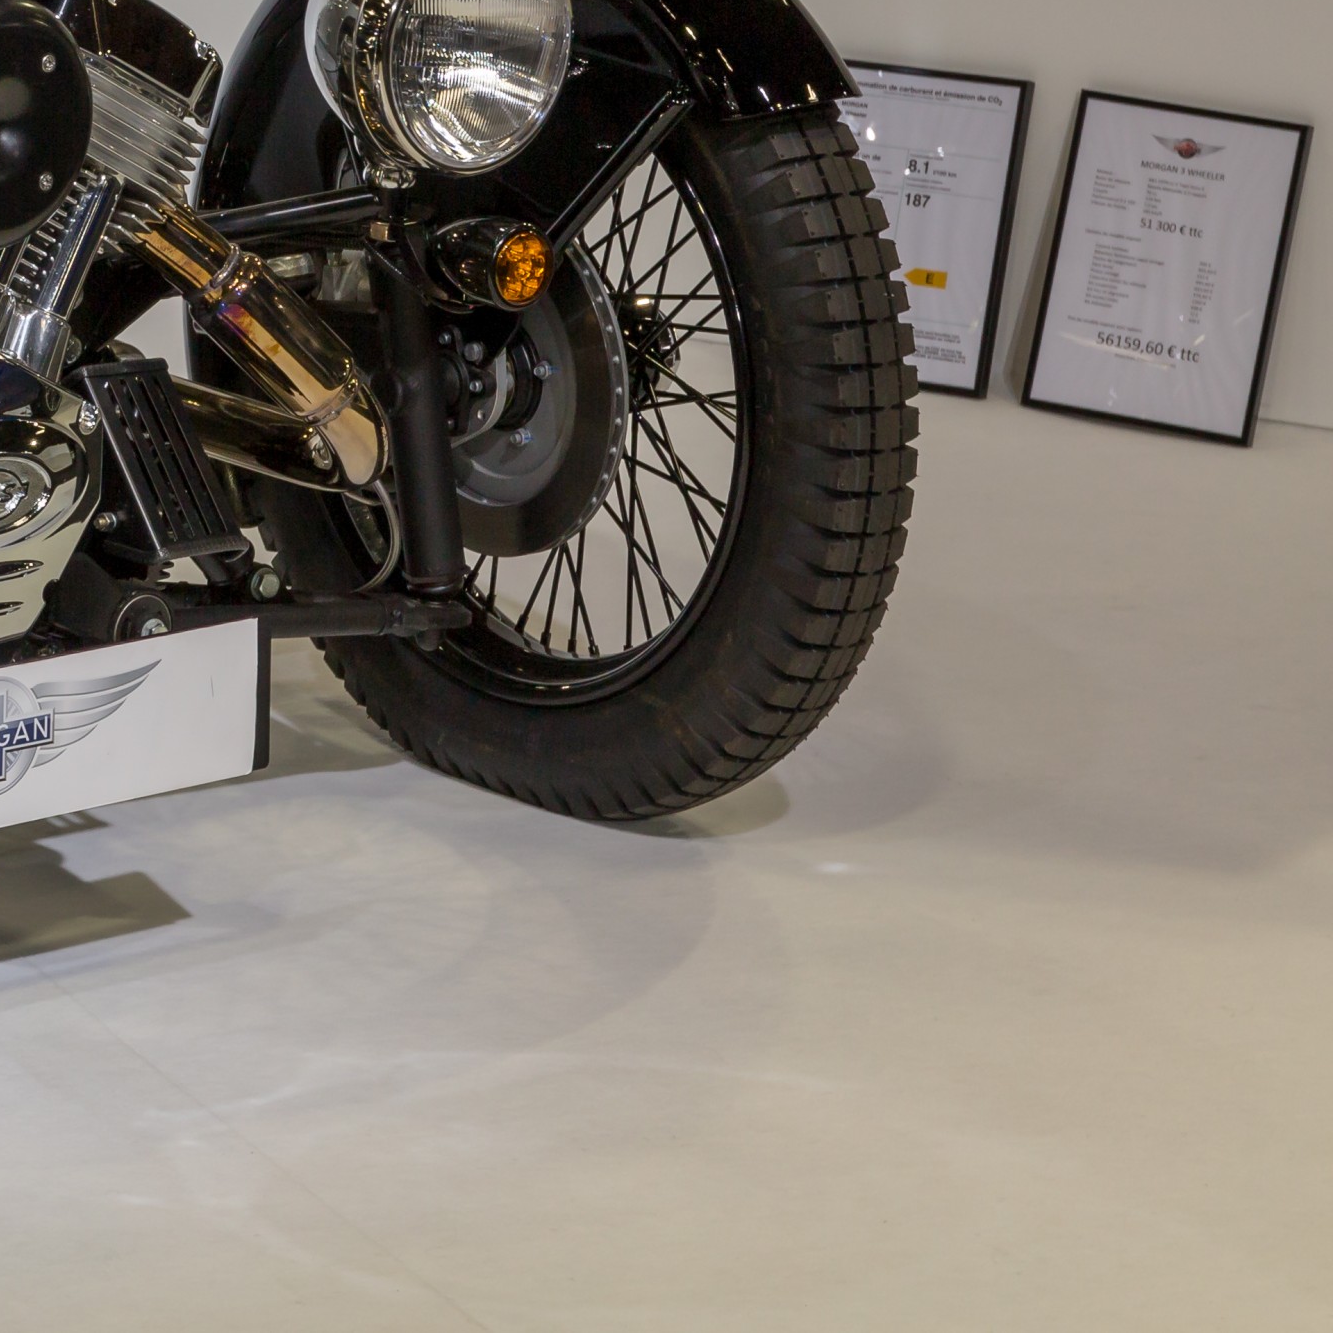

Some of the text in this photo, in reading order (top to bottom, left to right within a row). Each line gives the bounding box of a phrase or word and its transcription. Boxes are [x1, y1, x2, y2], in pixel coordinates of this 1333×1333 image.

[908, 159, 929, 174] 8.1
[1141, 160, 1179, 173] MORGAN
[1187, 167, 1225, 181] WHEELER
[905, 193, 931, 208] 187
[1140, 218, 1152, 230] 51
[1155, 221, 1176, 233] 300
[925, 272, 935, 285] E
[1097, 331, 1164, 355] 56159,60
[1168, 345, 1177, 358] €
[1180, 348, 1199, 363] ttc
